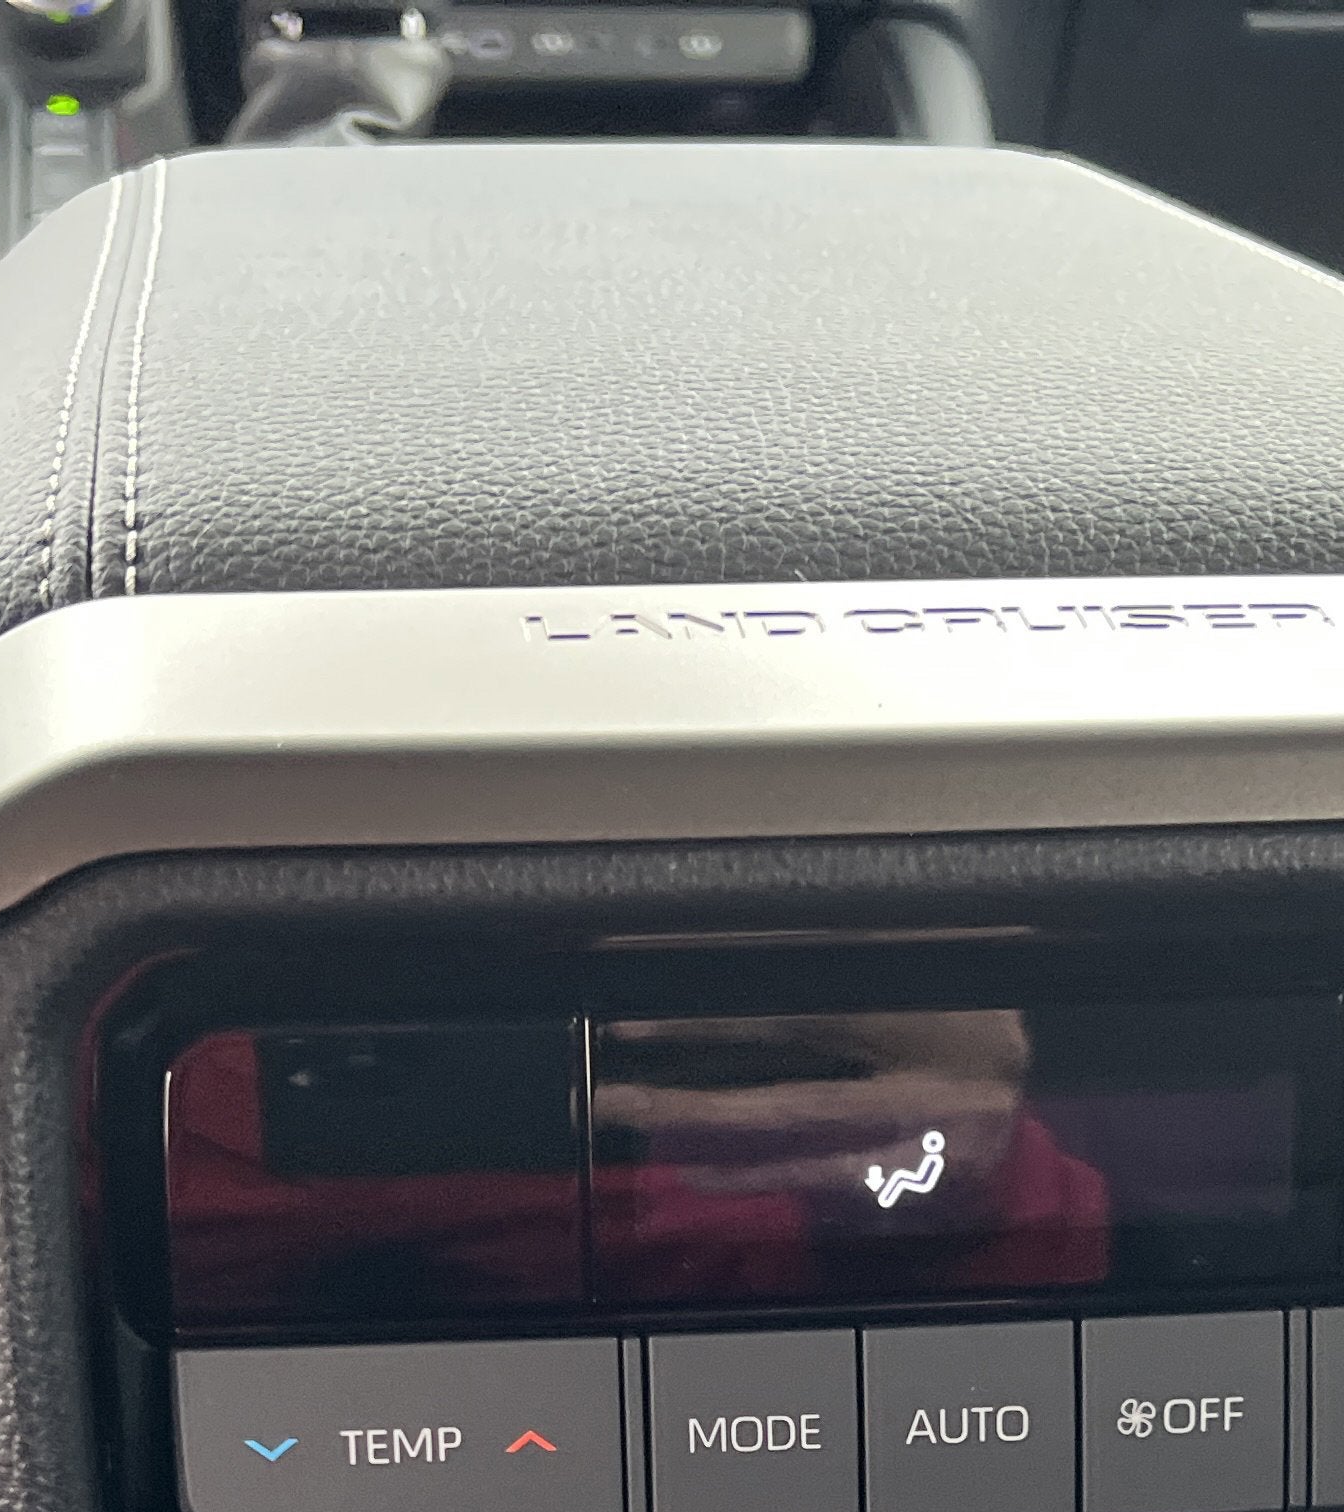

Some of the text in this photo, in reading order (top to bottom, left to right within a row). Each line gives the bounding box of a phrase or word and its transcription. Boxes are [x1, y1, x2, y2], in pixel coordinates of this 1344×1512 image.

[522, 602, 1336, 640] LAND CRUISER
[689, 1414, 823, 1454] MODE
[906, 1406, 1030, 1445] AUTO
[1164, 1397, 1246, 1434] OFF
[339, 1427, 463, 1466] TEMP
